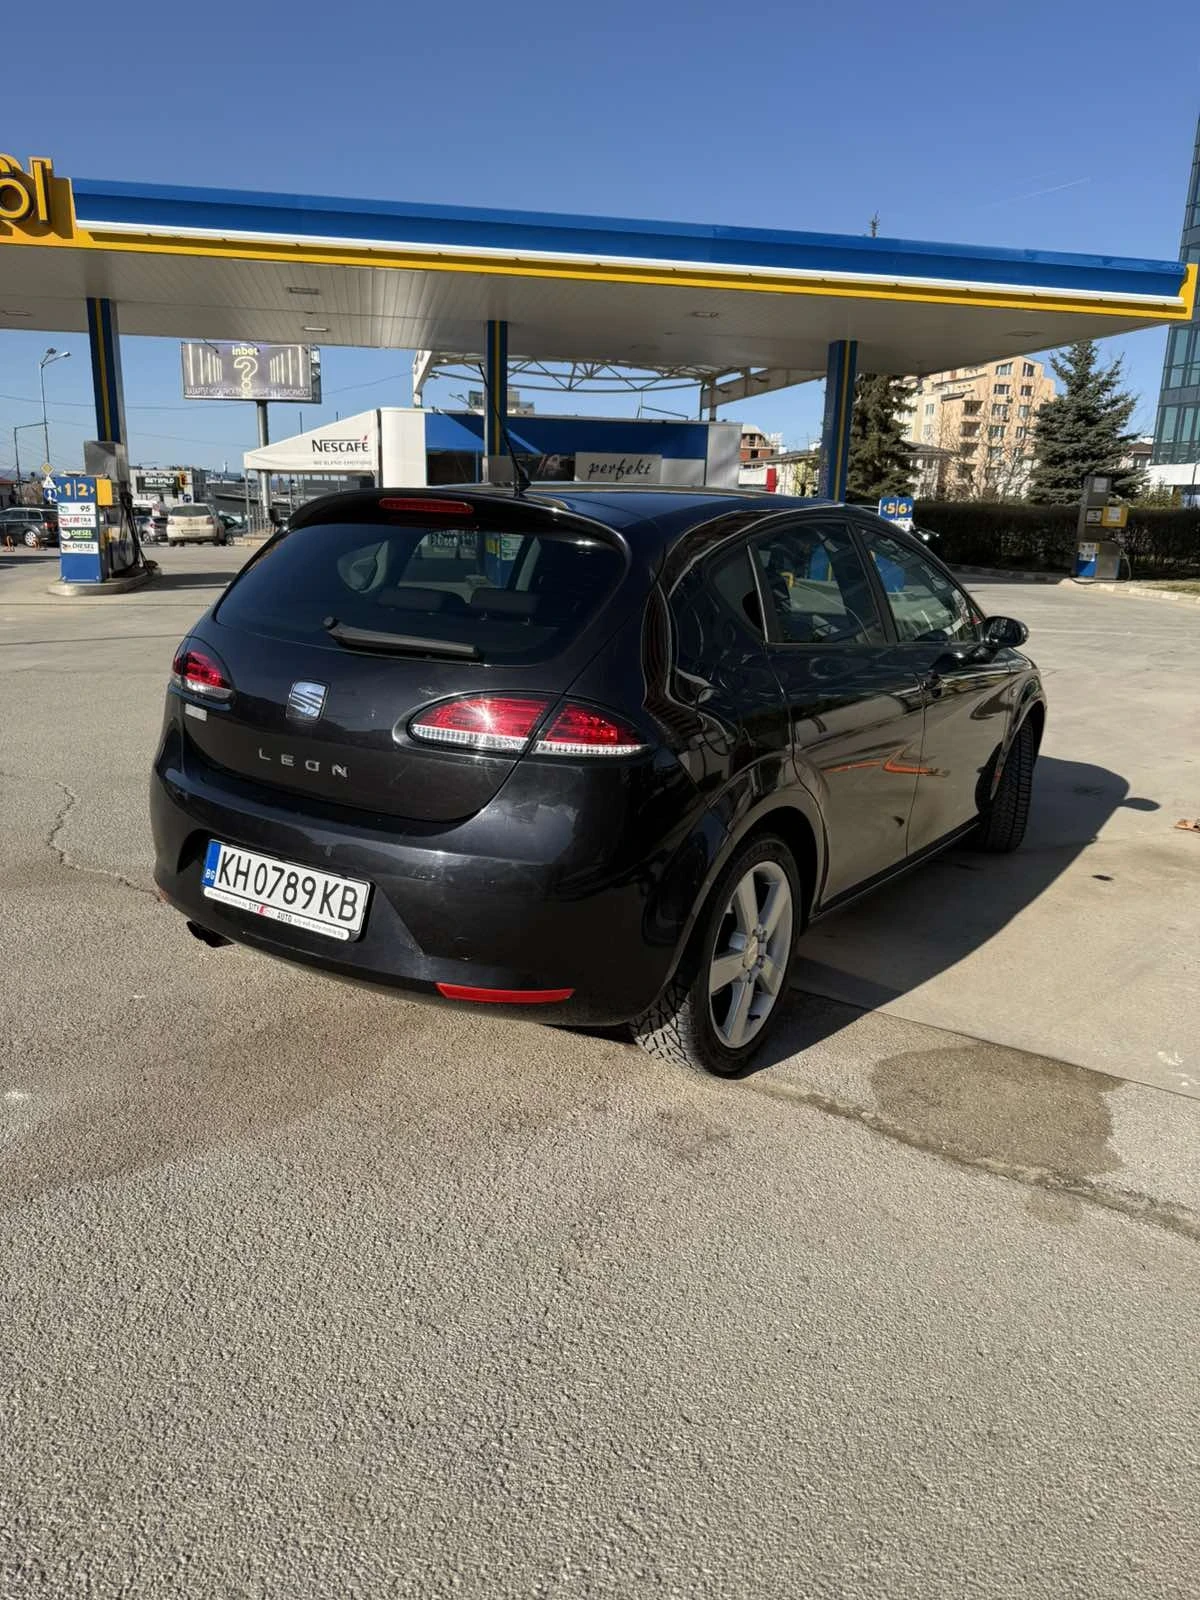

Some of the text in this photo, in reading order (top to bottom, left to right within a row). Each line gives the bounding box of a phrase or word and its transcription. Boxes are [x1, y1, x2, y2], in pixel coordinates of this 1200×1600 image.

[231, 345, 258, 356] inbet
[312, 435, 369, 453] NESCAFÉ
[588, 458, 652, 481] perfekt
[65, 483, 88, 496] 1 2
[887, 503, 907, 514] 5 6
[259, 748, 348, 778] LEON
[205, 869, 215, 880] BG
[218, 851, 358, 922] KH0789KB
